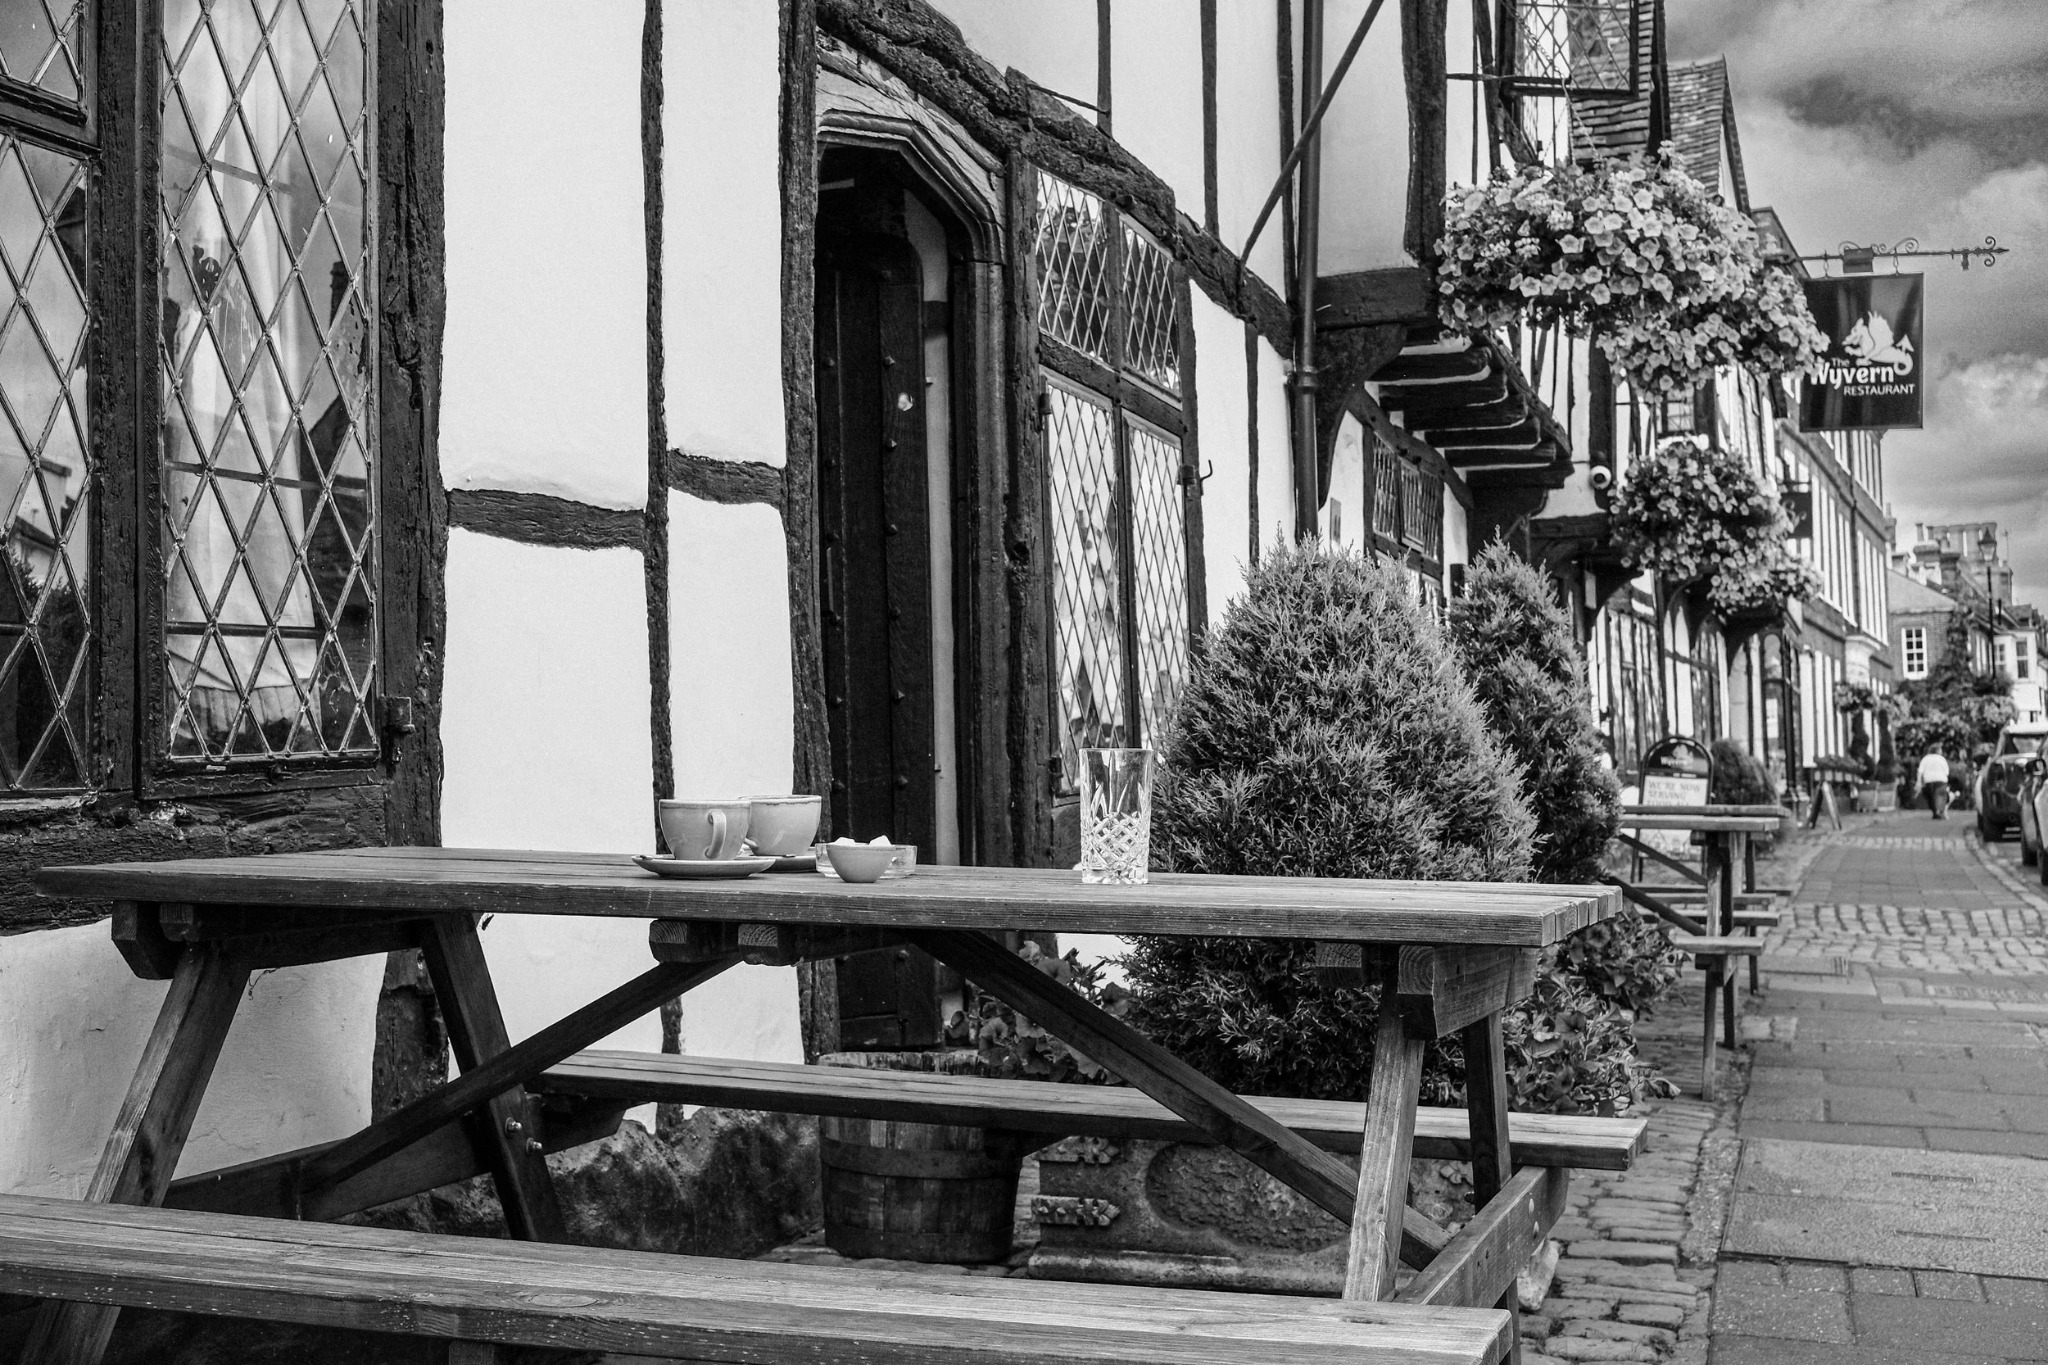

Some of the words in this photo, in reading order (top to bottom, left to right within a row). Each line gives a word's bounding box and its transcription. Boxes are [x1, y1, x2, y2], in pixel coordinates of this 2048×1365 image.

[1830, 357, 1850, 368] The
[1811, 361, 1895, 390] Wyvern
[1843, 384, 1915, 396] RESTAURANT
